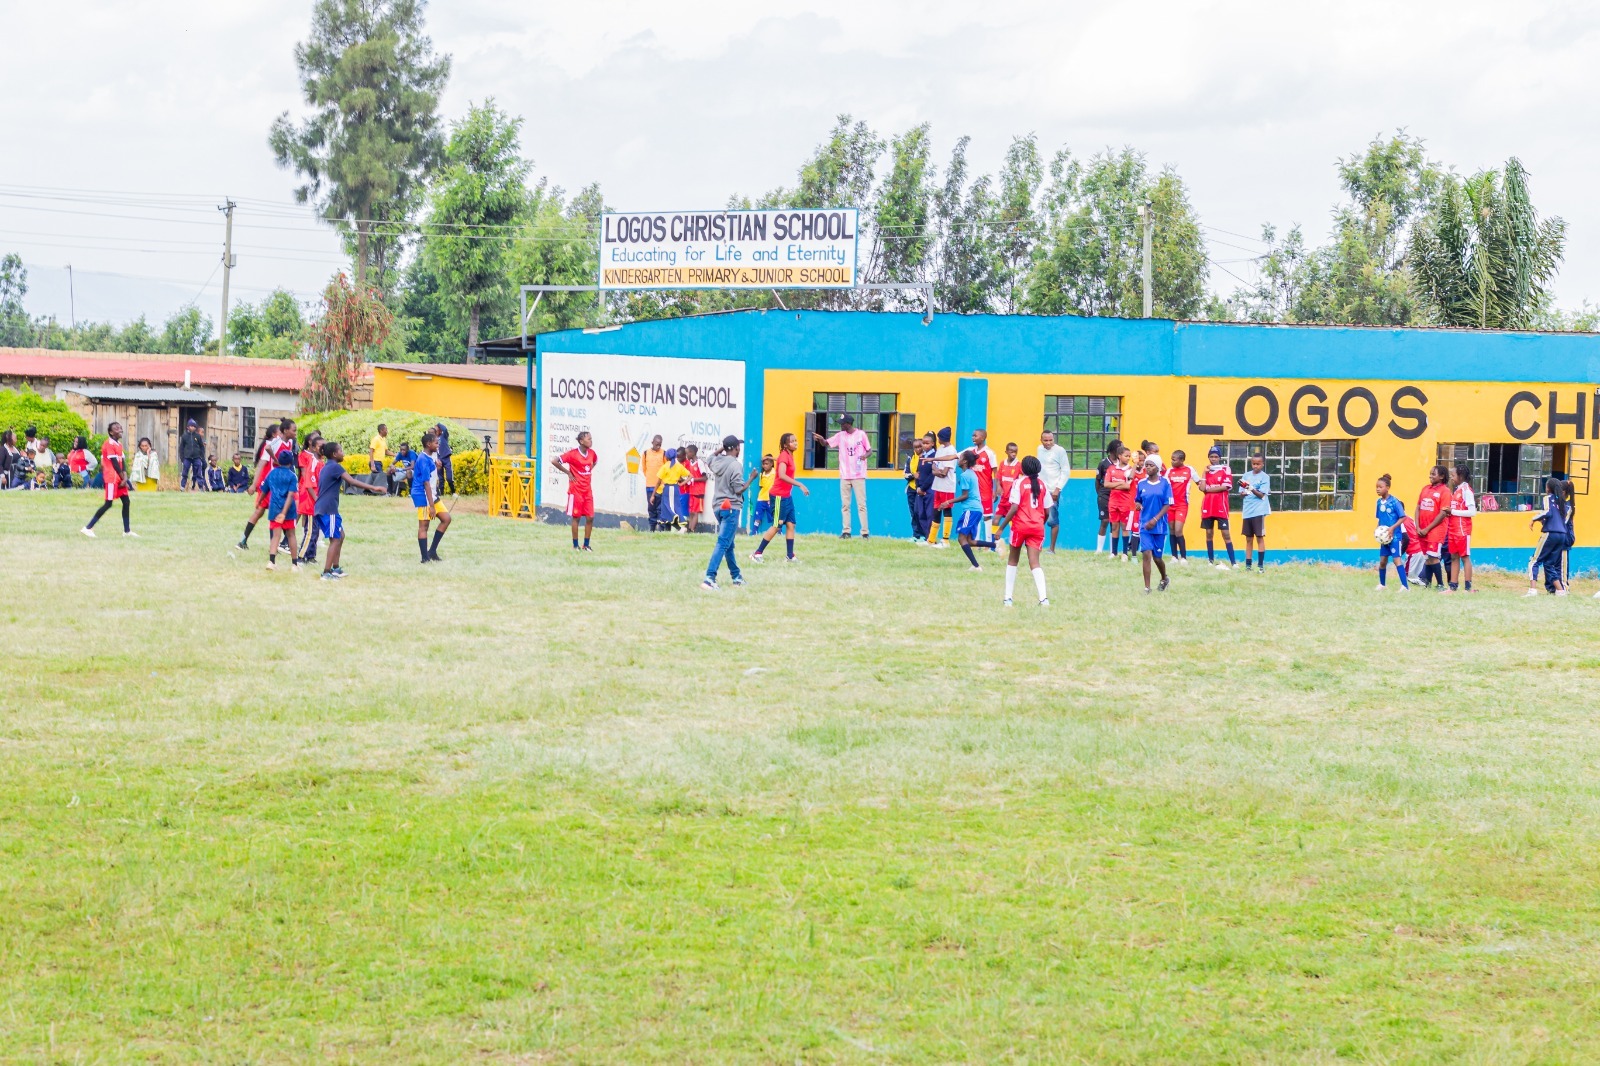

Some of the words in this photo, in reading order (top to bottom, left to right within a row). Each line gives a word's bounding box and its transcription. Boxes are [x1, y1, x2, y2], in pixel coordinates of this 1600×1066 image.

[605, 215, 667, 243] LOGOS
[670, 214, 767, 242] CHRISTIAN
[773, 212, 854, 241] SCHOOL
[612, 247, 676, 266] Educating
[685, 245, 706, 262] for
[715, 244, 742, 261] Life
[752, 245, 778, 262] and
[787, 244, 846, 264] Eternity
[749, 267, 793, 283] JUNIOR
[799, 267, 850, 283] SCHOOL
[550, 377, 595, 401] LOGOS
[598, 381, 675, 405] CHRISTIAN
[678, 384, 737, 409] SCHOOL
[567, 407, 587, 418] VALUES
[617, 403, 635, 415] OUR
[639, 405, 658, 417] DNA
[1187, 383, 1429, 440] LOGOS
[690, 421, 721, 437] VISION
[549, 434, 570, 443] BELONG
